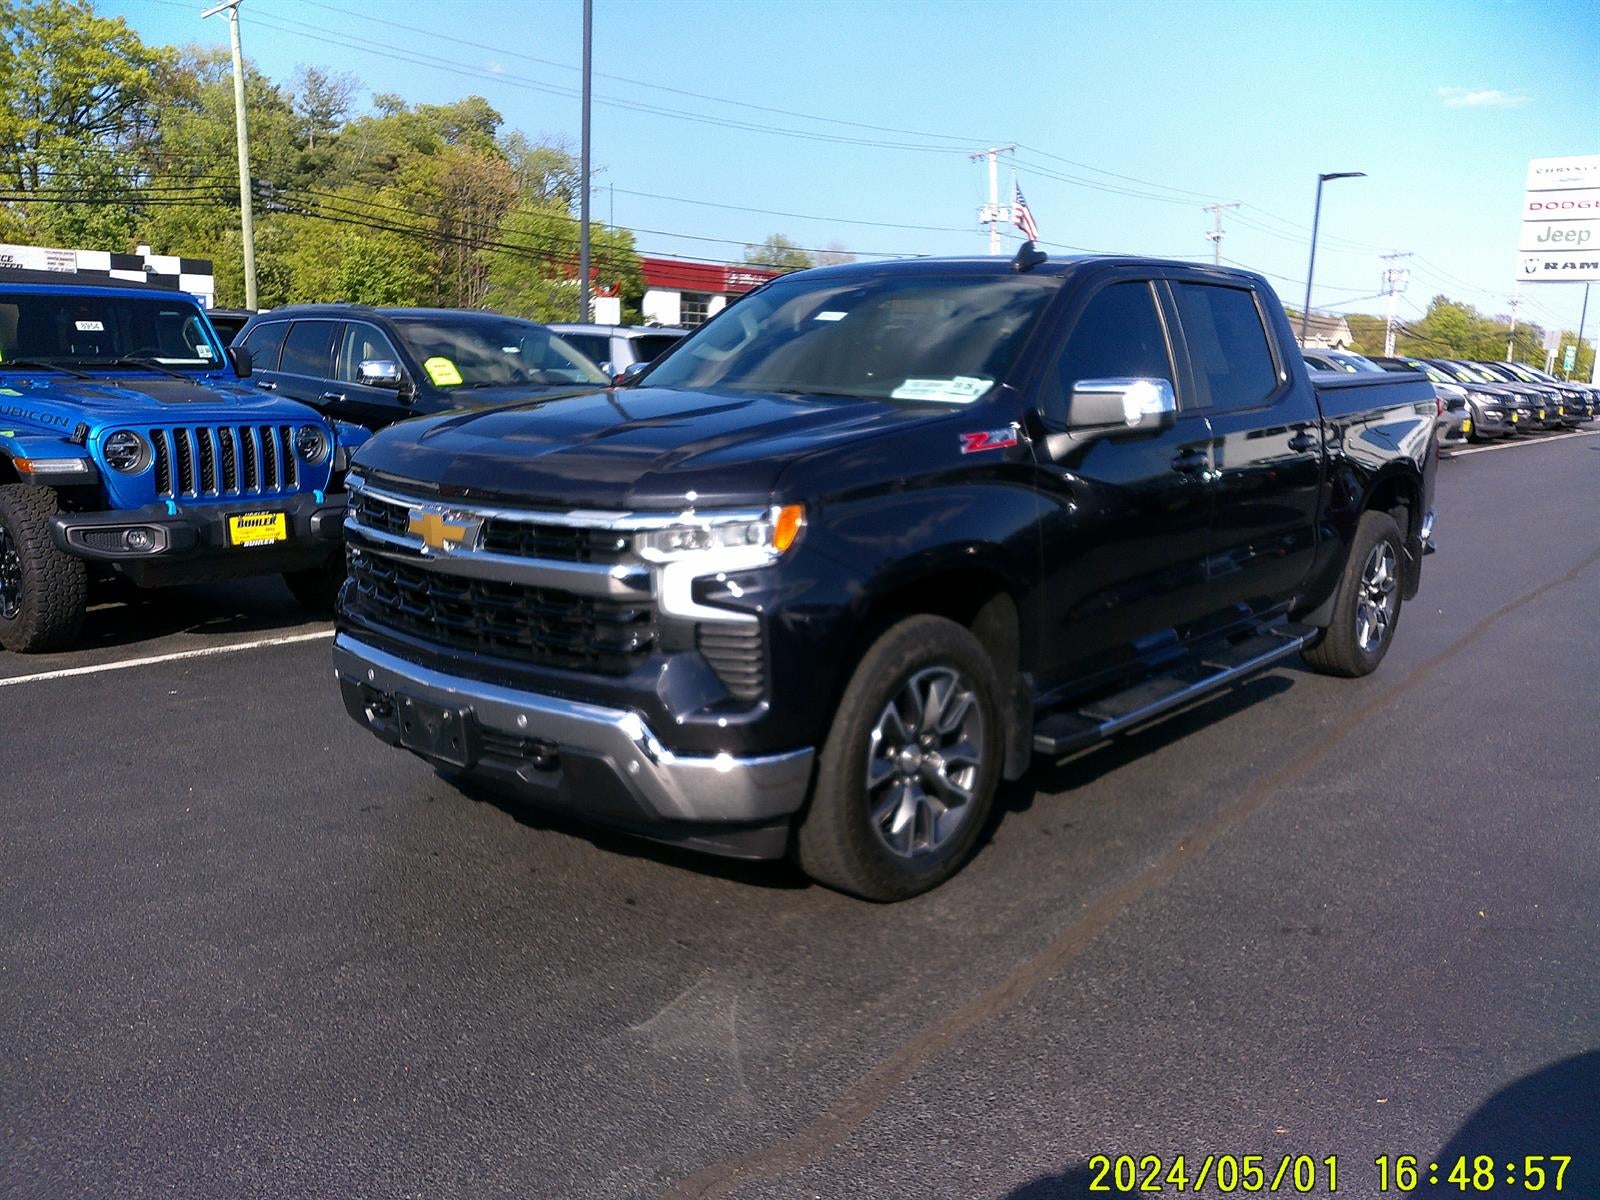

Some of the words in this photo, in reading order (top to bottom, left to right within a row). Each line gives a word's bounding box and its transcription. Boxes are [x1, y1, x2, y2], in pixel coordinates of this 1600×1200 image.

[1537, 226, 1591, 246] Jeep
[0, 254, 14, 263] CE
[1544, 262, 1599, 271] RAM
